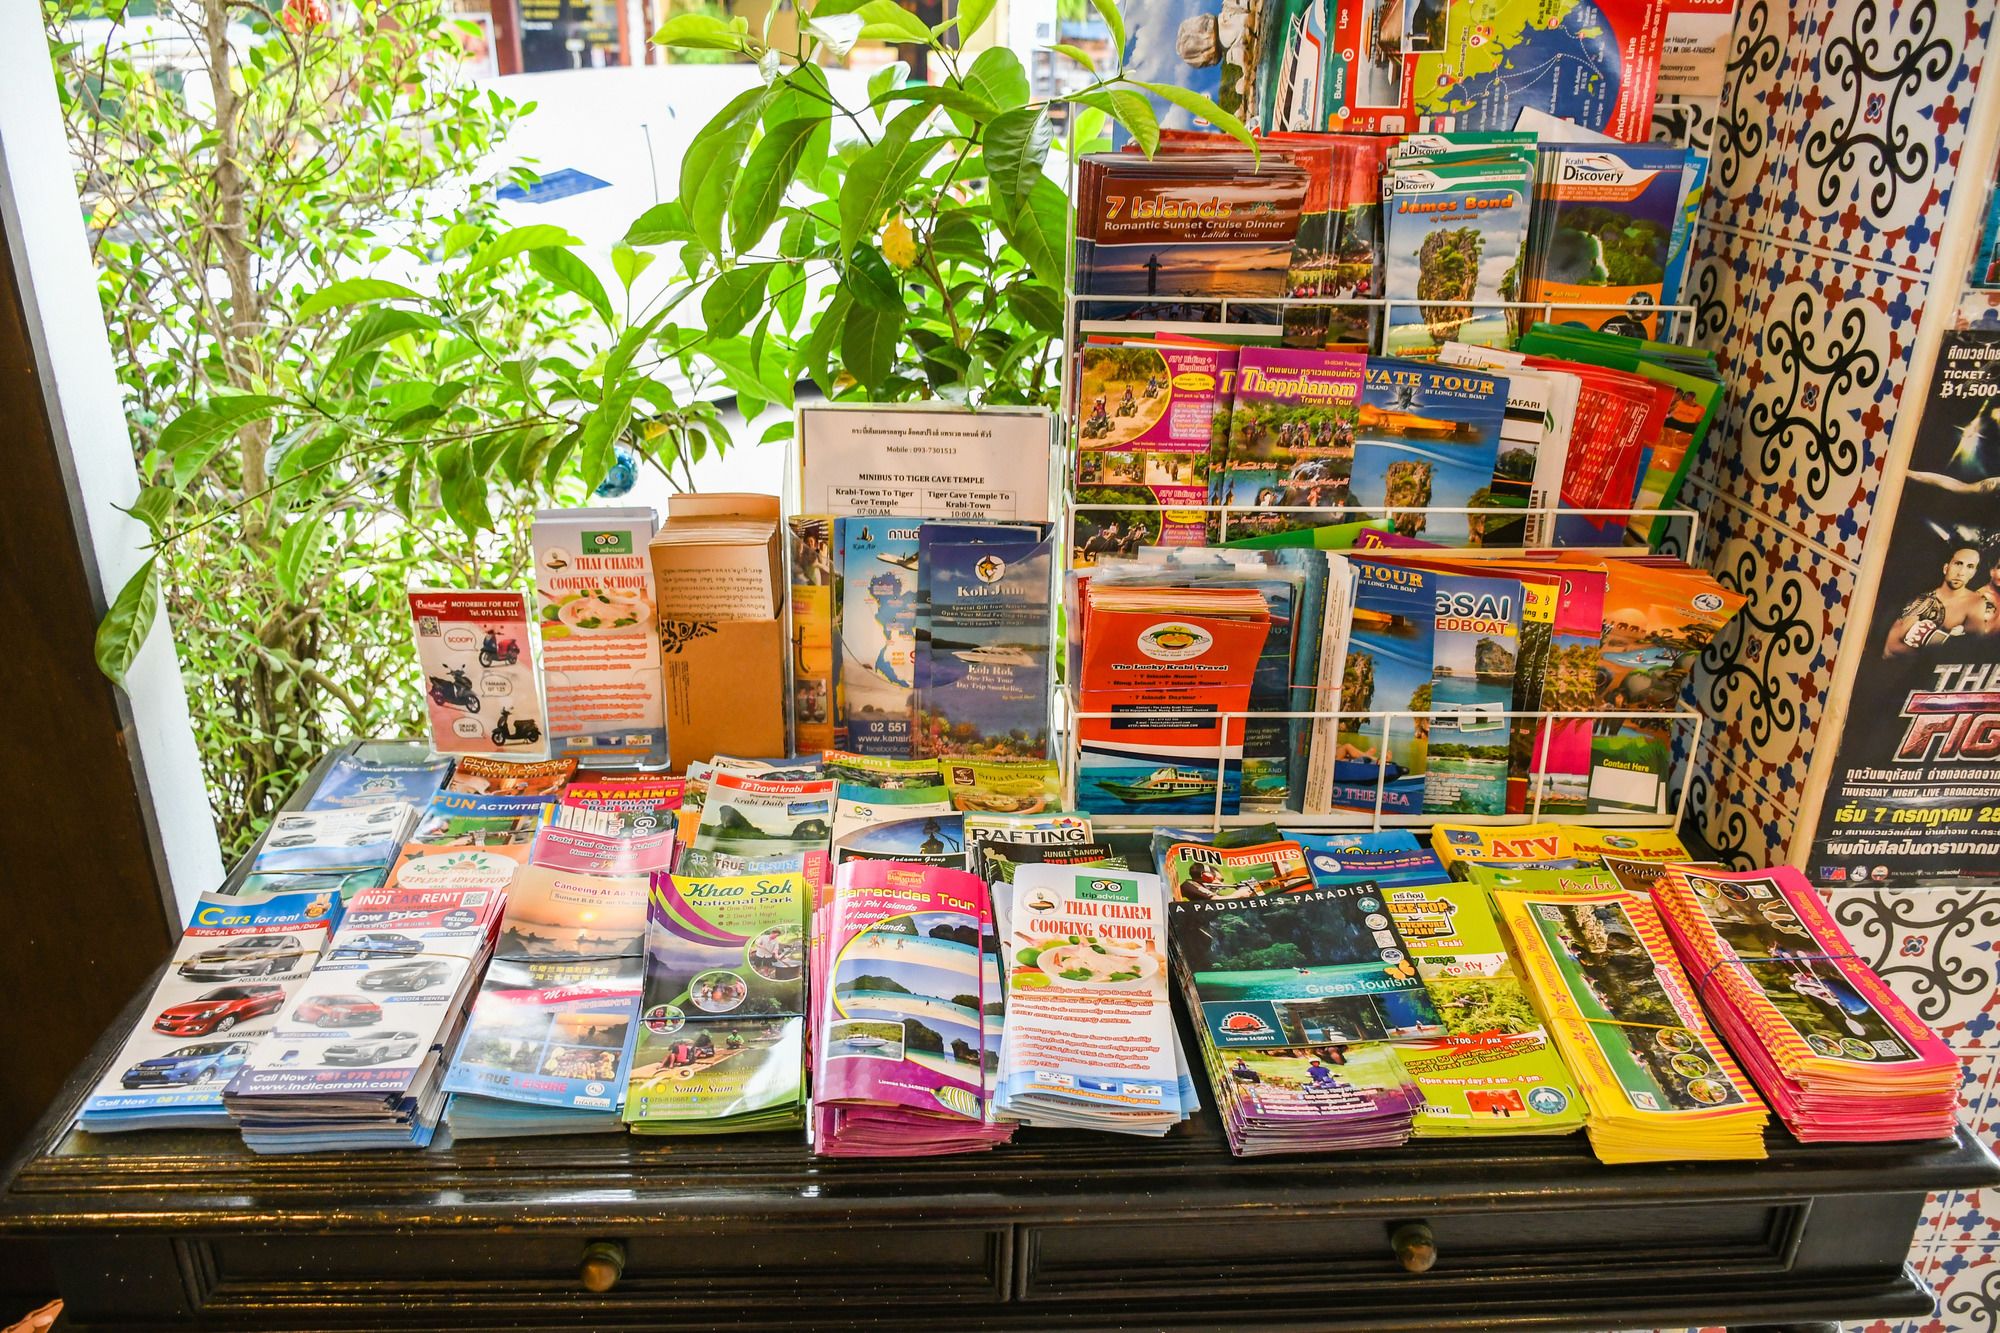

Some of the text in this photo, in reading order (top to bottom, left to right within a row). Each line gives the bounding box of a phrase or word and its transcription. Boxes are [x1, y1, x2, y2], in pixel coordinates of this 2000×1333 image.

[1338, 8, 1348, 29] Lipe
[1614, 37, 1638, 139] Andaman Inter Line
[1565, 157, 1584, 165] Krabi
[1563, 165, 1624, 183] Discovery
[1395, 180, 1435, 191] Discovery
[1106, 195, 1233, 219] 7 Islands
[1398, 194, 1514, 214] James Bond
[1104, 220, 1286, 231] Romantic Sunset Cruise Dinner
[1201, 230, 1230, 239] Lalida
[1944, 370, 1986, 380] TICKET
[1241, 367, 1357, 398] Thepphanom
[1429, 374, 1495, 394] TOUR
[1301, 396, 1325, 404] Travel
[1334, 397, 1353, 406] Tour
[859, 473, 985, 484] MINIBUS TO TIGER CAVE TEMPLE
[835, 487, 914, 499] Krabi-Town To Tiger
[928, 491, 948, 500] Tiger
[969, 492, 999, 501] Temple
[999, 493, 1010, 501] To
[850, 498, 899, 507] Cave Temple
[945, 501, 991, 509] Krabi-Town
[857, 508, 877, 516] 07:00
[951, 510, 970, 518] 10:00
[574, 555, 646, 571] THAI CHARM
[1361, 565, 1424, 588] TOUR
[549, 575, 650, 592] COOKING SCHOOL
[1368, 580, 1384, 588] LONG
[1385, 582, 1399, 590] TAIL
[1400, 585, 1417, 593] BOAT
[450, 600, 487, 608] MOTORBIKE
[488, 600, 502, 608] FOR
[502, 600, 520, 608] RENT
[469, 609, 519, 617] Tel. 075 611 511
[968, 664, 990, 675] Koh
[1133, 663, 1165, 671] Lucky
[870, 722, 907, 732] 02 551
[1603, 758, 1650, 772] Contact Here
[740, 781, 804, 793] TP Travel krabi
[1841, 787, 1889, 797] THURSDAY
[1892, 787, 1919, 797] NIGHT
[1922, 787, 1941, 797] LIVE
[568, 788, 680, 799] KAYAKING
[607, 798, 665, 806] THALANE
[1834, 800, 1868, 823] เริ่ม
[1873, 807, 1888, 823] 7
[1891, 806, 1974, 828] กรกฎาคม
[971, 828, 1086, 843] RAFTING
[1042, 848, 1105, 858] JUNGLE CANOPY
[1455, 836, 1560, 859] P.P. ATV
[1572, 842, 1686, 859] Andaman Krabi
[1178, 846, 1301, 868] FUN ACTIVITIES
[683, 879, 793, 899] Khao Sok
[1558, 876, 1618, 892] Krabi
[692, 896, 793, 907] National Park
[836, 887, 976, 911] Barracudas Tour
[1081, 891, 1130, 902] tripadvisor
[1175, 885, 1375, 913] A PADDLER'S PARADISE
[846, 900, 919, 912] Phi Phi Islands
[1064, 899, 1152, 920] THAI CHARM
[198, 907, 301, 927] Cars for rent
[348, 910, 430, 923] Low Price
[844, 921, 907, 932] Hong Islands
[1030, 918, 1156, 941] COOKING SCHOOL
[1406, 927, 1436, 936] PARK
[1423, 956, 1461, 975] ways to
[238, 973, 303, 984] NISSAN ALMERA
[1305, 975, 1418, 995] Green Tourism
[226, 1031, 257, 1040] SUZUKI
[253, 1072, 308, 1082] Call Now
[673, 1084, 704, 1094] South
[96, 1097, 148, 1108] Call Now
